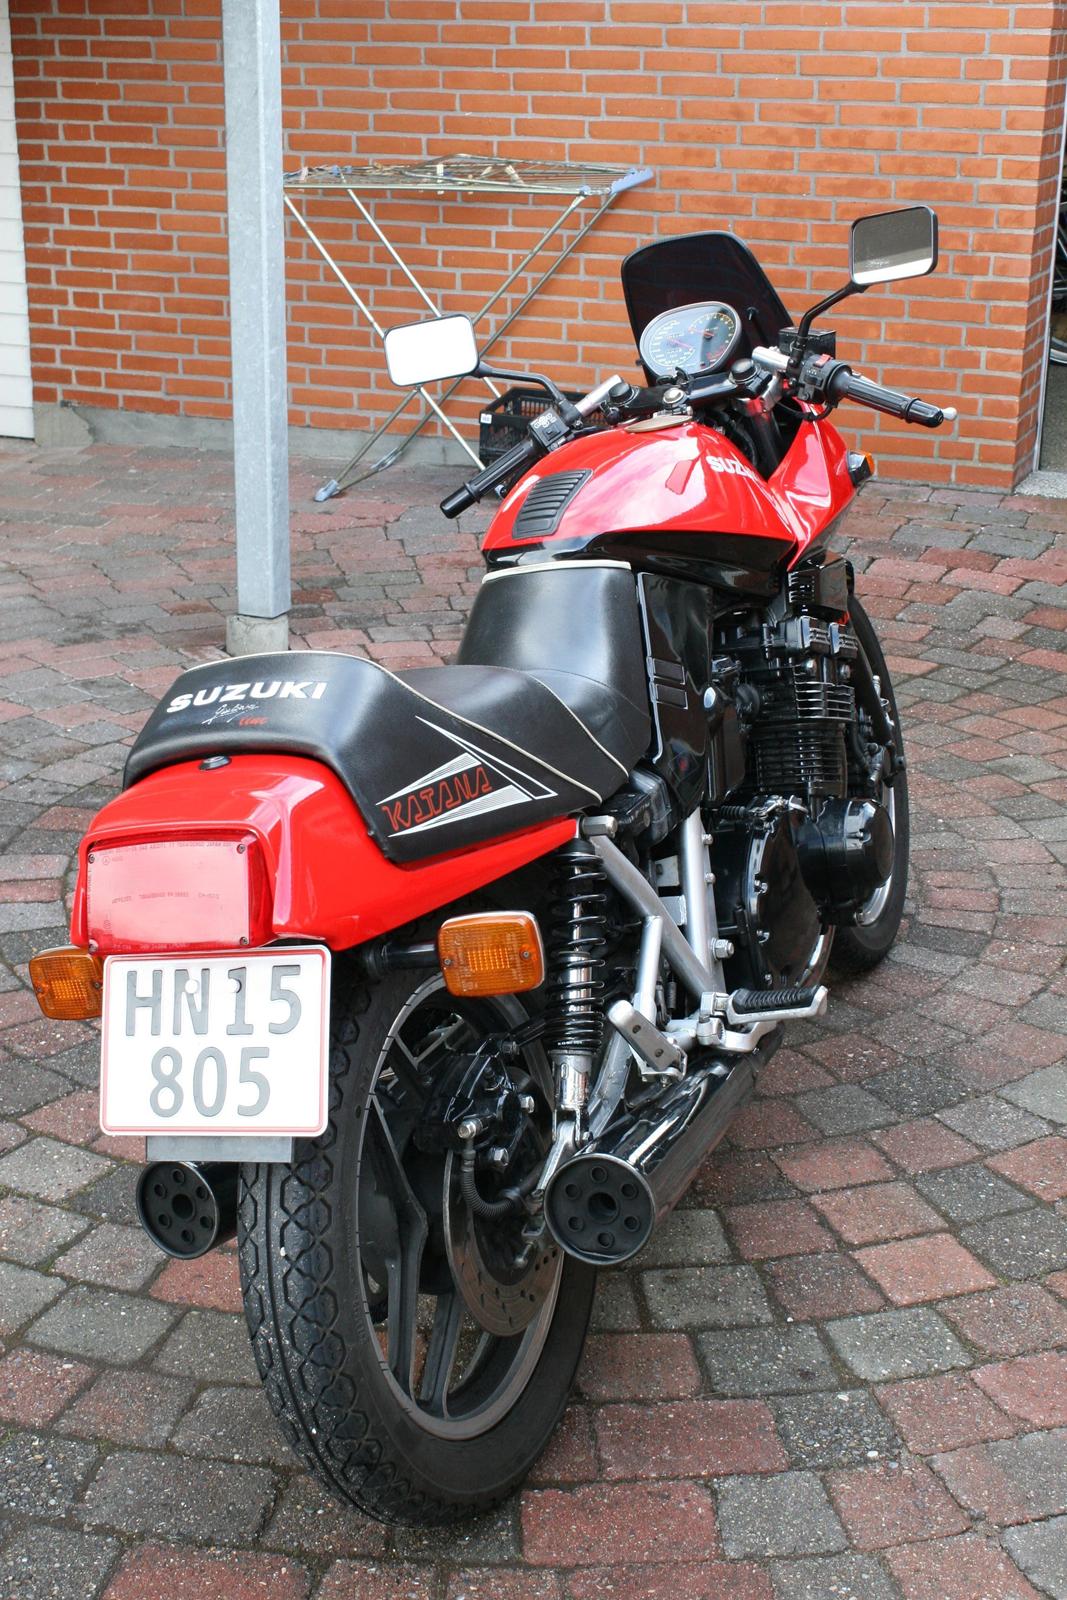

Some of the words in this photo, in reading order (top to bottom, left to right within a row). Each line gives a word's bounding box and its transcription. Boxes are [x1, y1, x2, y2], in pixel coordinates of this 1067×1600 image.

[166, 681, 328, 713] SUZUKI
[381, 766, 493, 832] KATANA
[149, 1046, 271, 1118] 805
